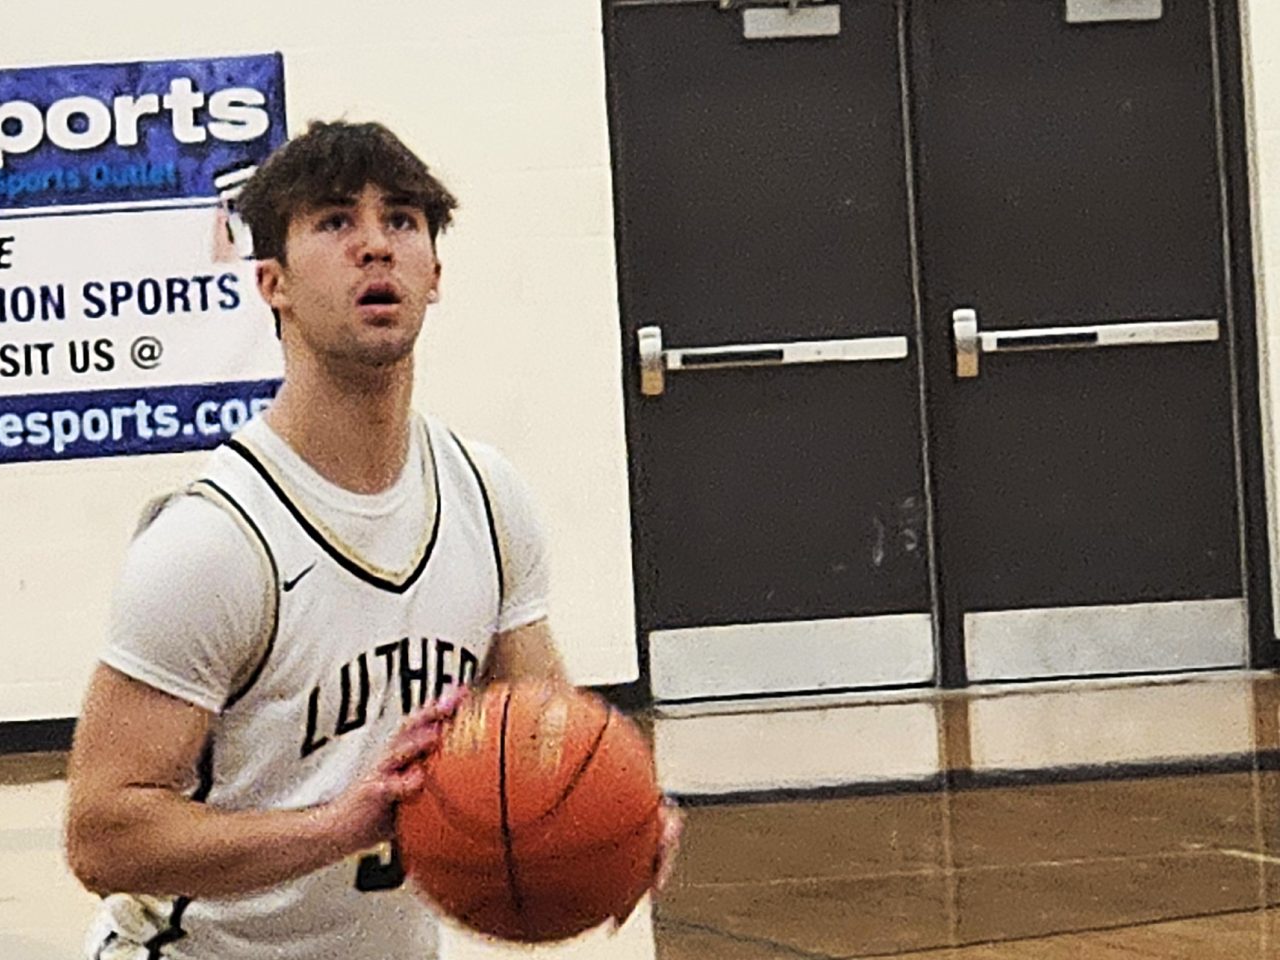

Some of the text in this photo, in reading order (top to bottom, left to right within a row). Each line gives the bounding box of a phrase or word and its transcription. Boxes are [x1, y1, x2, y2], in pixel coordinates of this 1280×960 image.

[90, 159, 177, 190] Outlet
[83, 272, 240, 319] SPORTS
[68, 338, 115, 374] US
[130, 336, 163, 370] @
